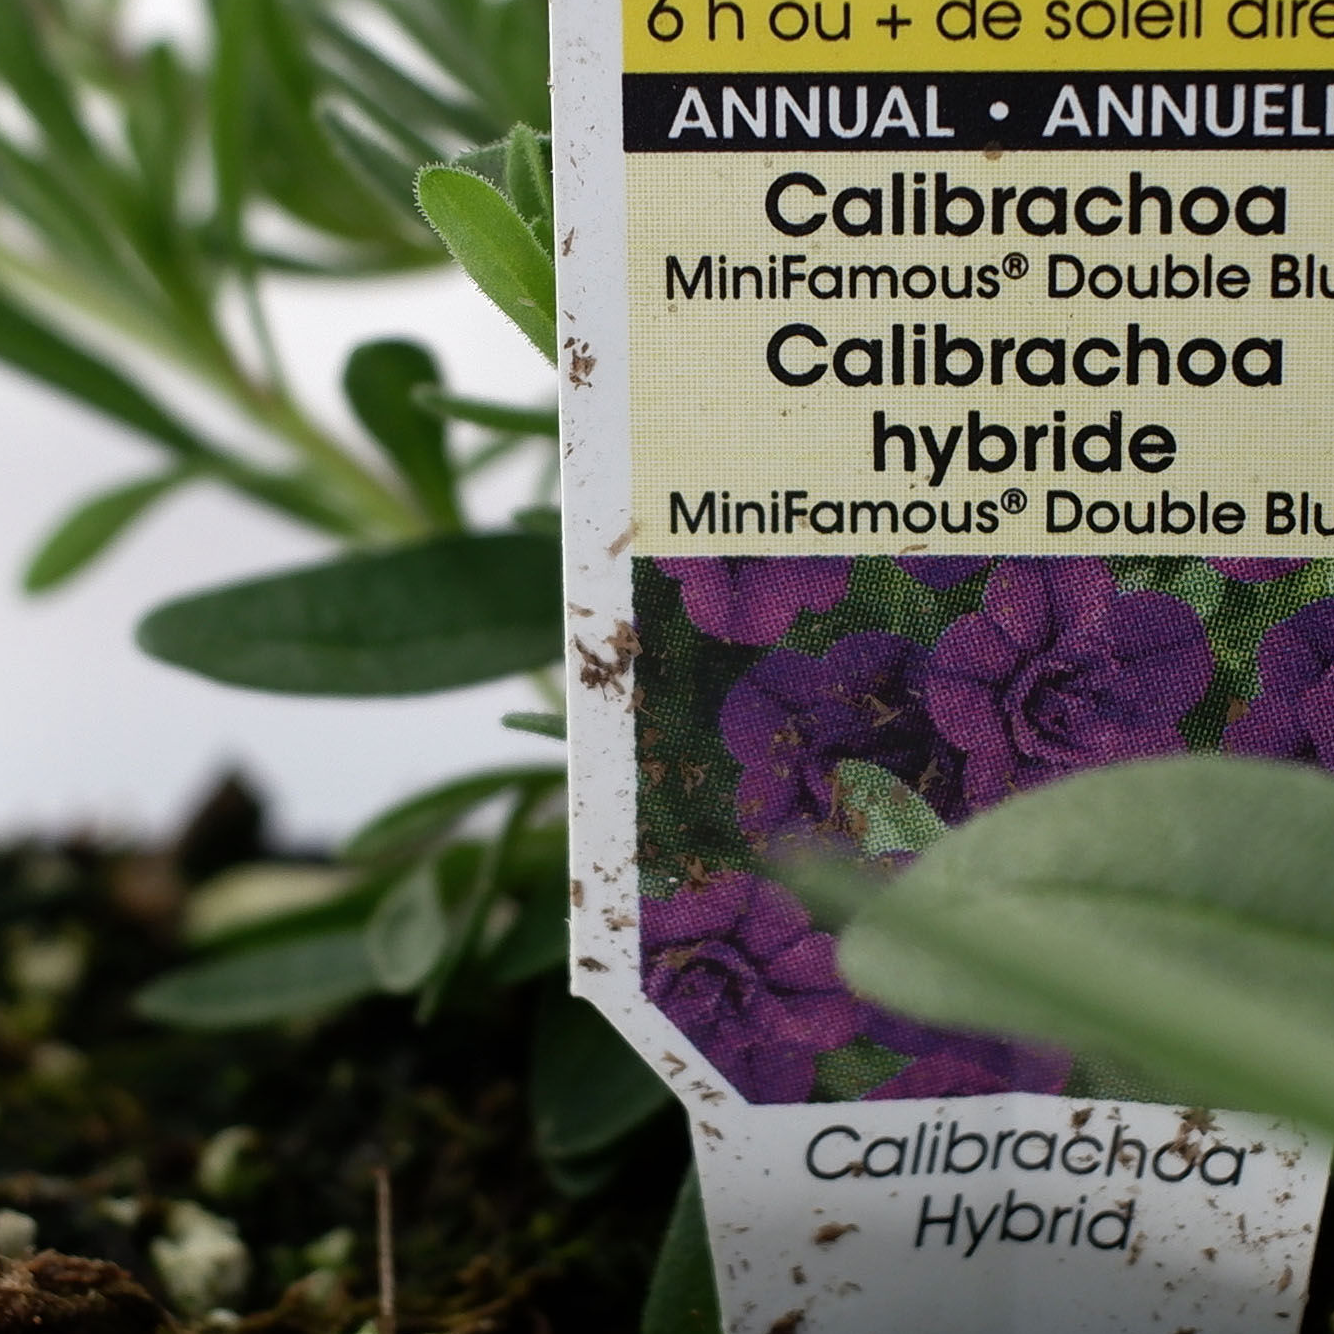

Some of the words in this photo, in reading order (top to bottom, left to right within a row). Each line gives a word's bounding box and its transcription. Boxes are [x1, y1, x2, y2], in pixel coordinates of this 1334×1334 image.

[668, 84, 955, 139] ANNUAL
[764, 172, 1288, 237] Calibrachoa
[1047, 255, 1251, 300] Double
[765, 322, 1284, 388] Calibrachoa
[872, 411, 1178, 486] hybride
[1046, 491, 1247, 535] Double
[805, 1119, 1247, 1187] Calibrachoa
[914, 1189, 1136, 1258] Hybrid
